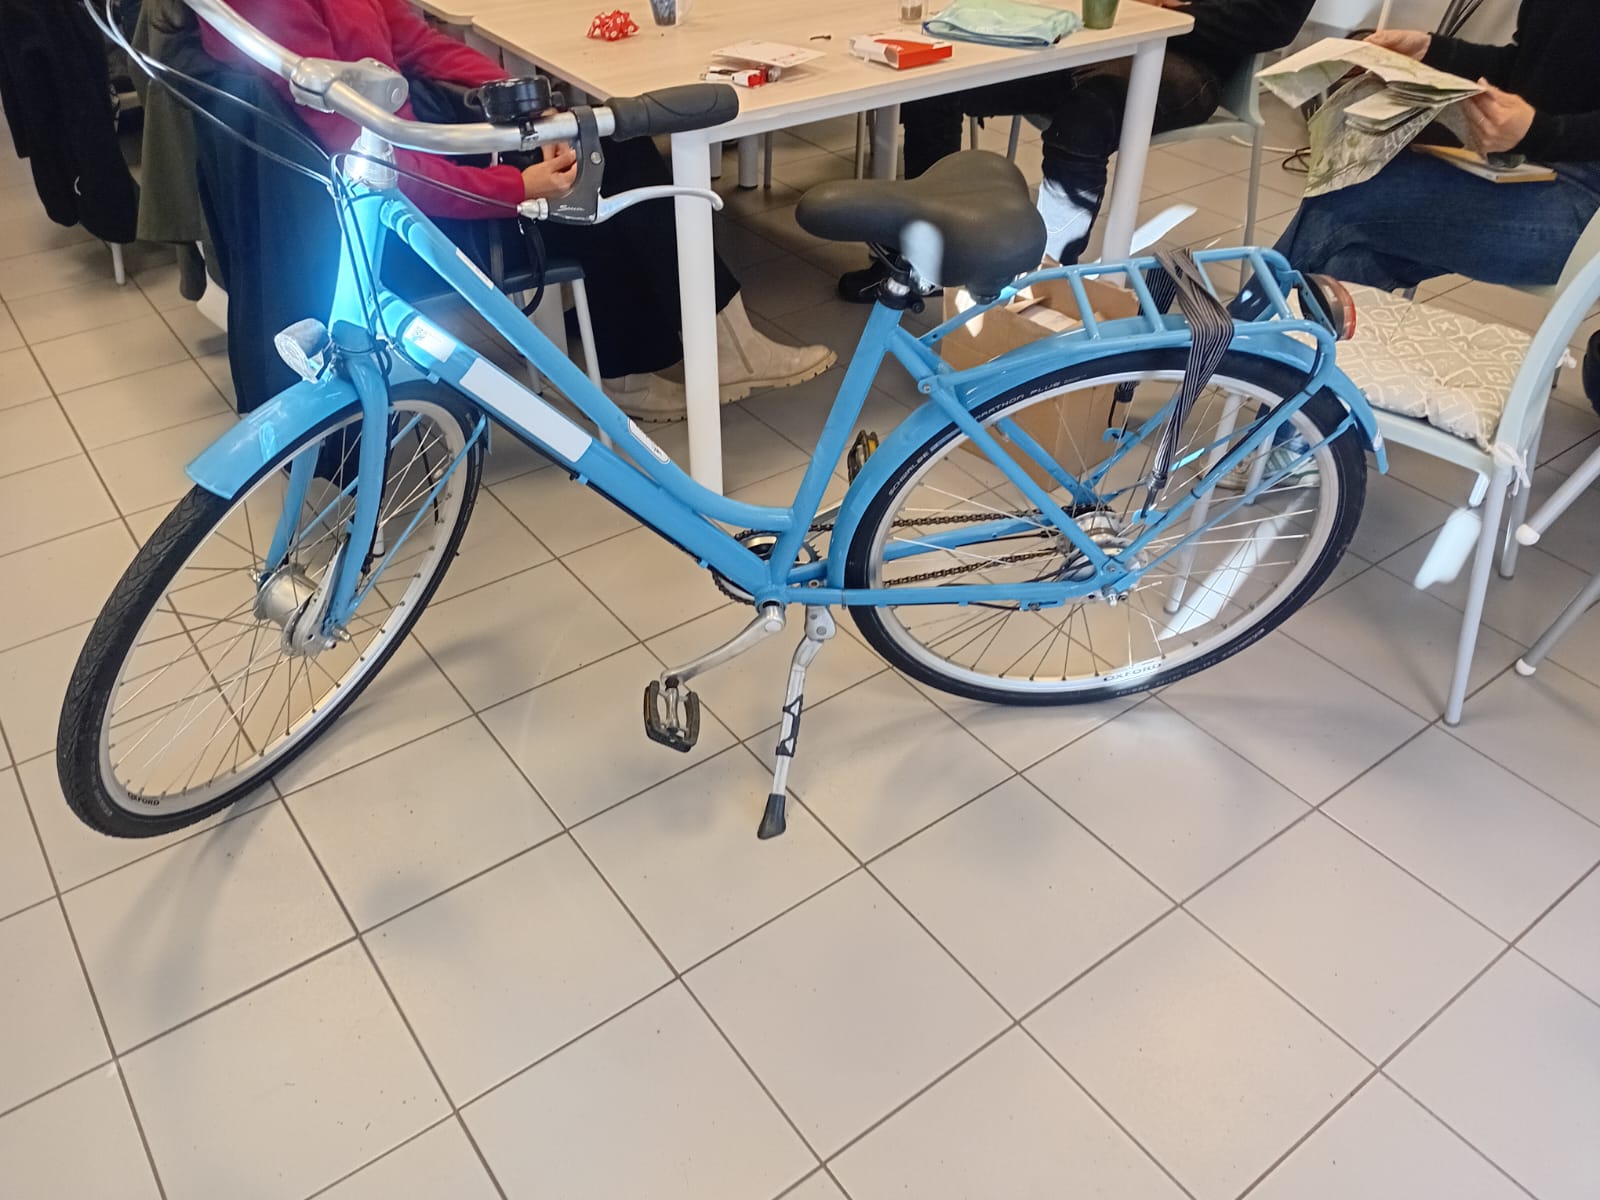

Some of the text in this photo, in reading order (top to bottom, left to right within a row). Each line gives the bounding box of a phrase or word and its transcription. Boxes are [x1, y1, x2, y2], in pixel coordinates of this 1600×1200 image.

[975, 381, 1061, 419] ARATHON PLUS
[888, 451, 930, 496] SCHWALBE
[1103, 662, 1162, 682] OXFORD
[127, 791, 160, 806] OXFORD
